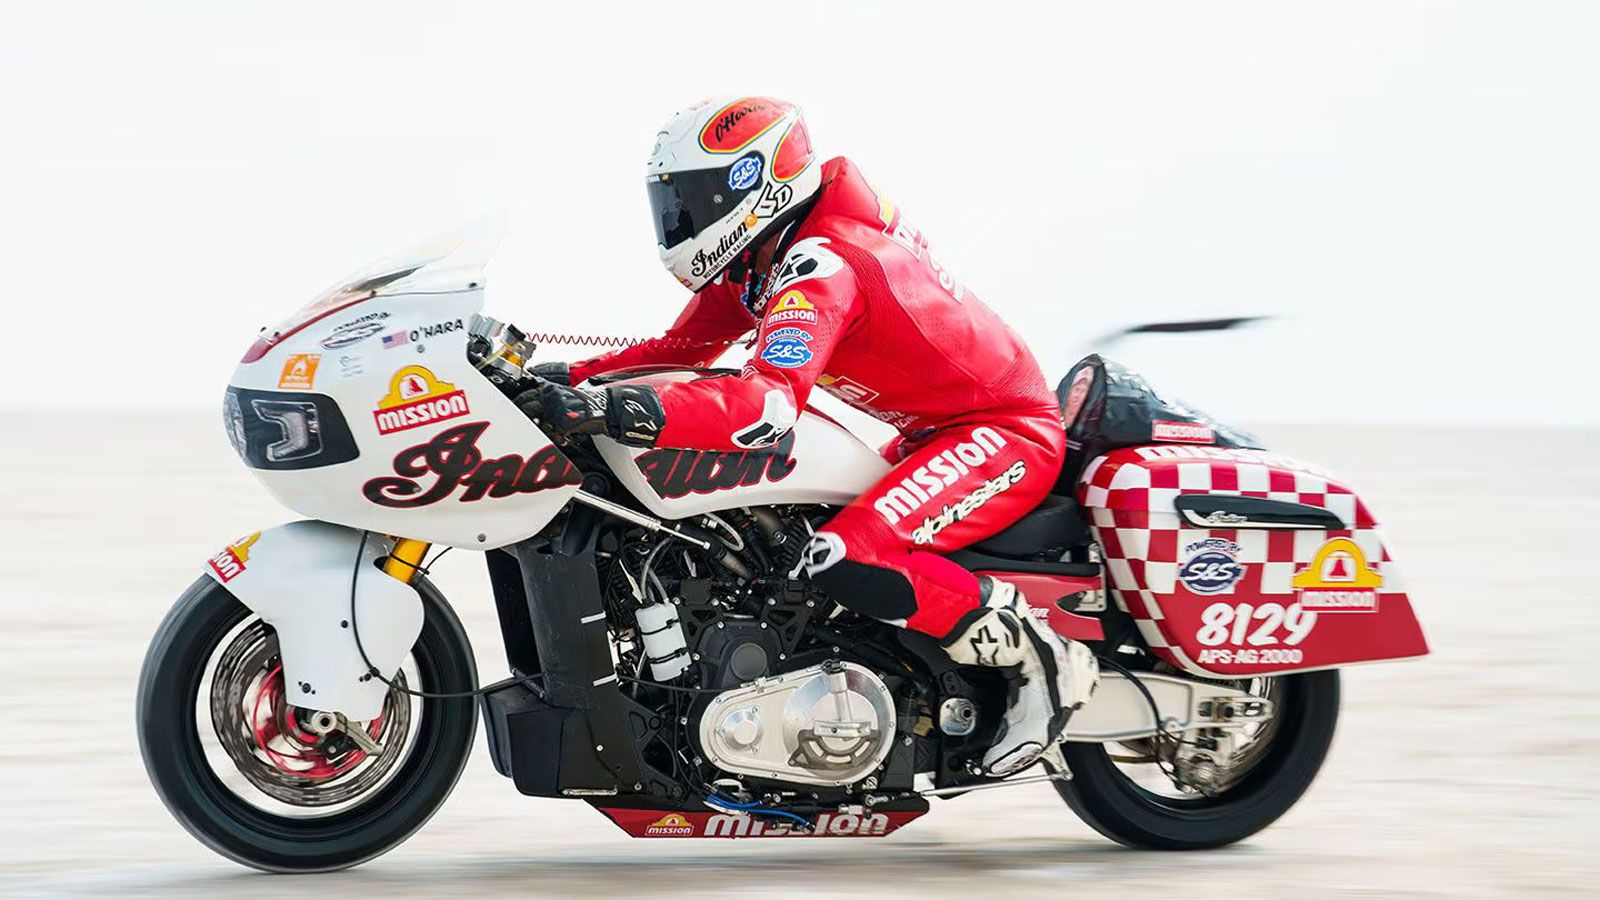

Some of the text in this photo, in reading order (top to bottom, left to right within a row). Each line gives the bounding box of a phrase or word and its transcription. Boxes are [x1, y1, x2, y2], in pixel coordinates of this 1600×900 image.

[732, 161, 758, 187] S&S
[691, 221, 748, 277] Indian
[702, 234, 752, 280] MOTORCYCLE RACING
[409, 318, 465, 342] O'HARA
[766, 345, 807, 359] S&S
[911, 459, 1027, 545] alpinestars
[1183, 563, 1235, 581] S&S
[1196, 602, 1318, 646] 8129
[1197, 649, 1303, 664] APS-AG 2000
